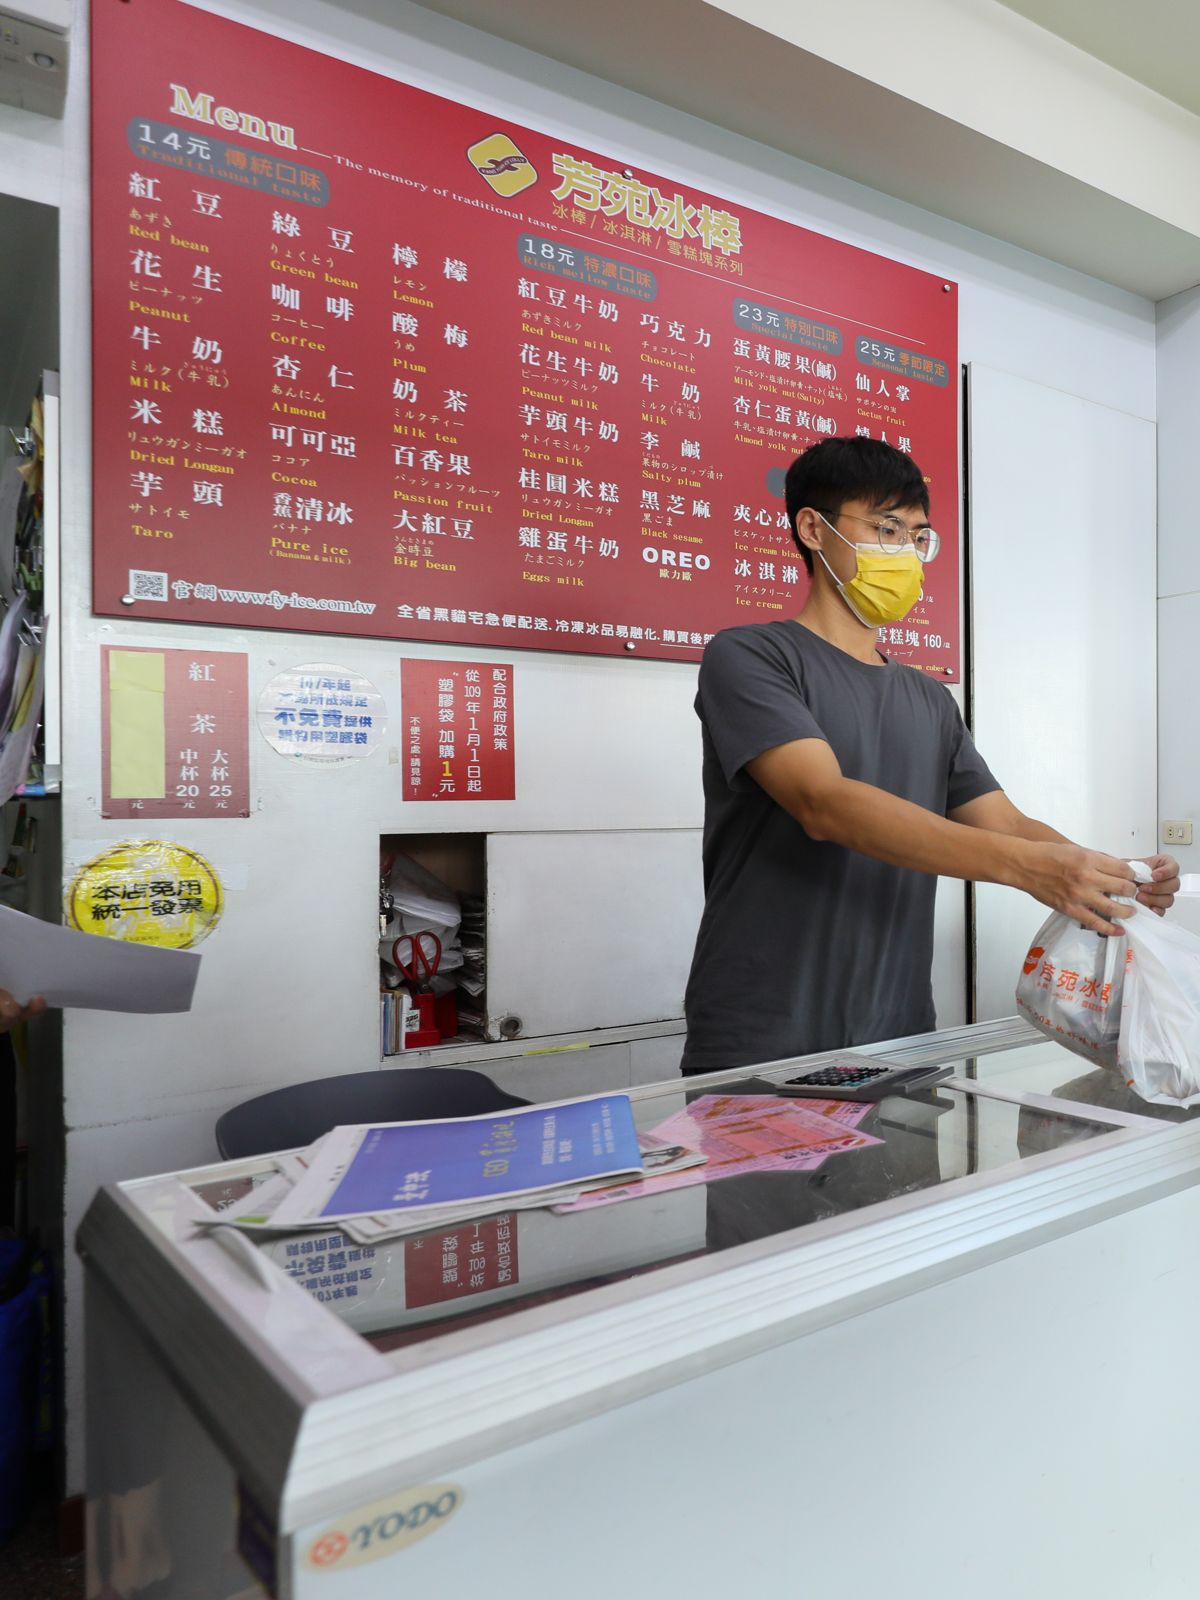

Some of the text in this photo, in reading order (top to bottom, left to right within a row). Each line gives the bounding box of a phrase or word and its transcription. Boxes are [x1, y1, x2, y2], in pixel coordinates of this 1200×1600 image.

[170, 82, 297, 150] Menu
[138, 124, 321, 192] 14元 傳統口味
[128, 172, 223, 219] 紅豆
[333, 153, 559, 232] The memory of traditional taste
[549, 151, 744, 256] 芳苑冰棒
[129, 223, 209, 253] Red bean
[271, 211, 354, 254] 綠豆
[392, 243, 468, 283] 檸檬
[523, 238, 575, 266] 18元
[129, 249, 222, 292] 花生
[270, 259, 358, 290] Green bean
[129, 301, 191, 322] Peanut
[271, 283, 355, 322] 咖啡
[393, 290, 434, 309] Lemon
[518, 277, 619, 323] 紅豆牛奶
[392, 311, 468, 348] 酸梅
[739, 303, 780, 328] 23元
[130, 325, 223, 364] 牛奶
[270, 331, 327, 352] Coffee
[522, 322, 612, 353] Red bean milk
[640, 313, 711, 348] 巧克力
[519, 342, 619, 385] 花生牛奶
[640, 353, 696, 374] Chocolate
[860, 341, 895, 362] 25元
[130, 375, 172, 392] Milk
[272, 355, 355, 390] 杏仁
[734, 376, 754, 388] Milk
[759, 382, 778, 394] yolk
[392, 378, 468, 413] 奶茶
[522, 385, 599, 411] Peanut milk
[641, 374, 700, 404] 牛奶
[856, 373, 910, 402] 仙人掌
[130, 399, 224, 436] 米糕
[272, 401, 327, 420] Almond
[519, 404, 620, 443] 芋頭牛奶
[641, 412, 667, 426] Milk
[857, 408, 906, 427] Cactus fruit
[269, 422, 357, 458] 可可亞
[393, 423, 458, 445] Milk tea
[734, 433, 787, 452] Almond yolk
[130, 450, 234, 475] Dried Longan
[392, 444, 471, 476] 百香果
[522, 447, 583, 468] Taro milk
[130, 471, 224, 507] 芋頭
[271, 472, 318, 488] Cocoa
[519, 467, 620, 503] 桂圓米糕
[642, 469, 701, 488] Salty plum
[393, 490, 493, 514] Passion fruit
[640, 490, 711, 519] 黑芝麻
[132, 524, 174, 540] Taro
[393, 509, 475, 540] 大紅豆
[522, 508, 594, 528] Dried Longan
[271, 537, 349, 556] Pure ice
[519, 526, 620, 560] 雞蛋牛奶
[641, 527, 703, 544] Black sesame
[735, 543, 749, 551] Ice
[753, 547, 778, 556] cream
[393, 556, 456, 572] Big bean
[642, 547, 711, 570] OREO
[734, 559, 799, 584] 冰淇淋
[522, 571, 584, 587] Eggs milk
[172, 580, 377, 615] 官網 www.fy-ice.com.tw
[735, 598, 783, 610] Ice cream
[907, 617, 930, 625] cream
[923, 634, 942, 649] 160
[925, 664, 945, 672] cubes
[492, 668, 508, 751] 配合政府政策
